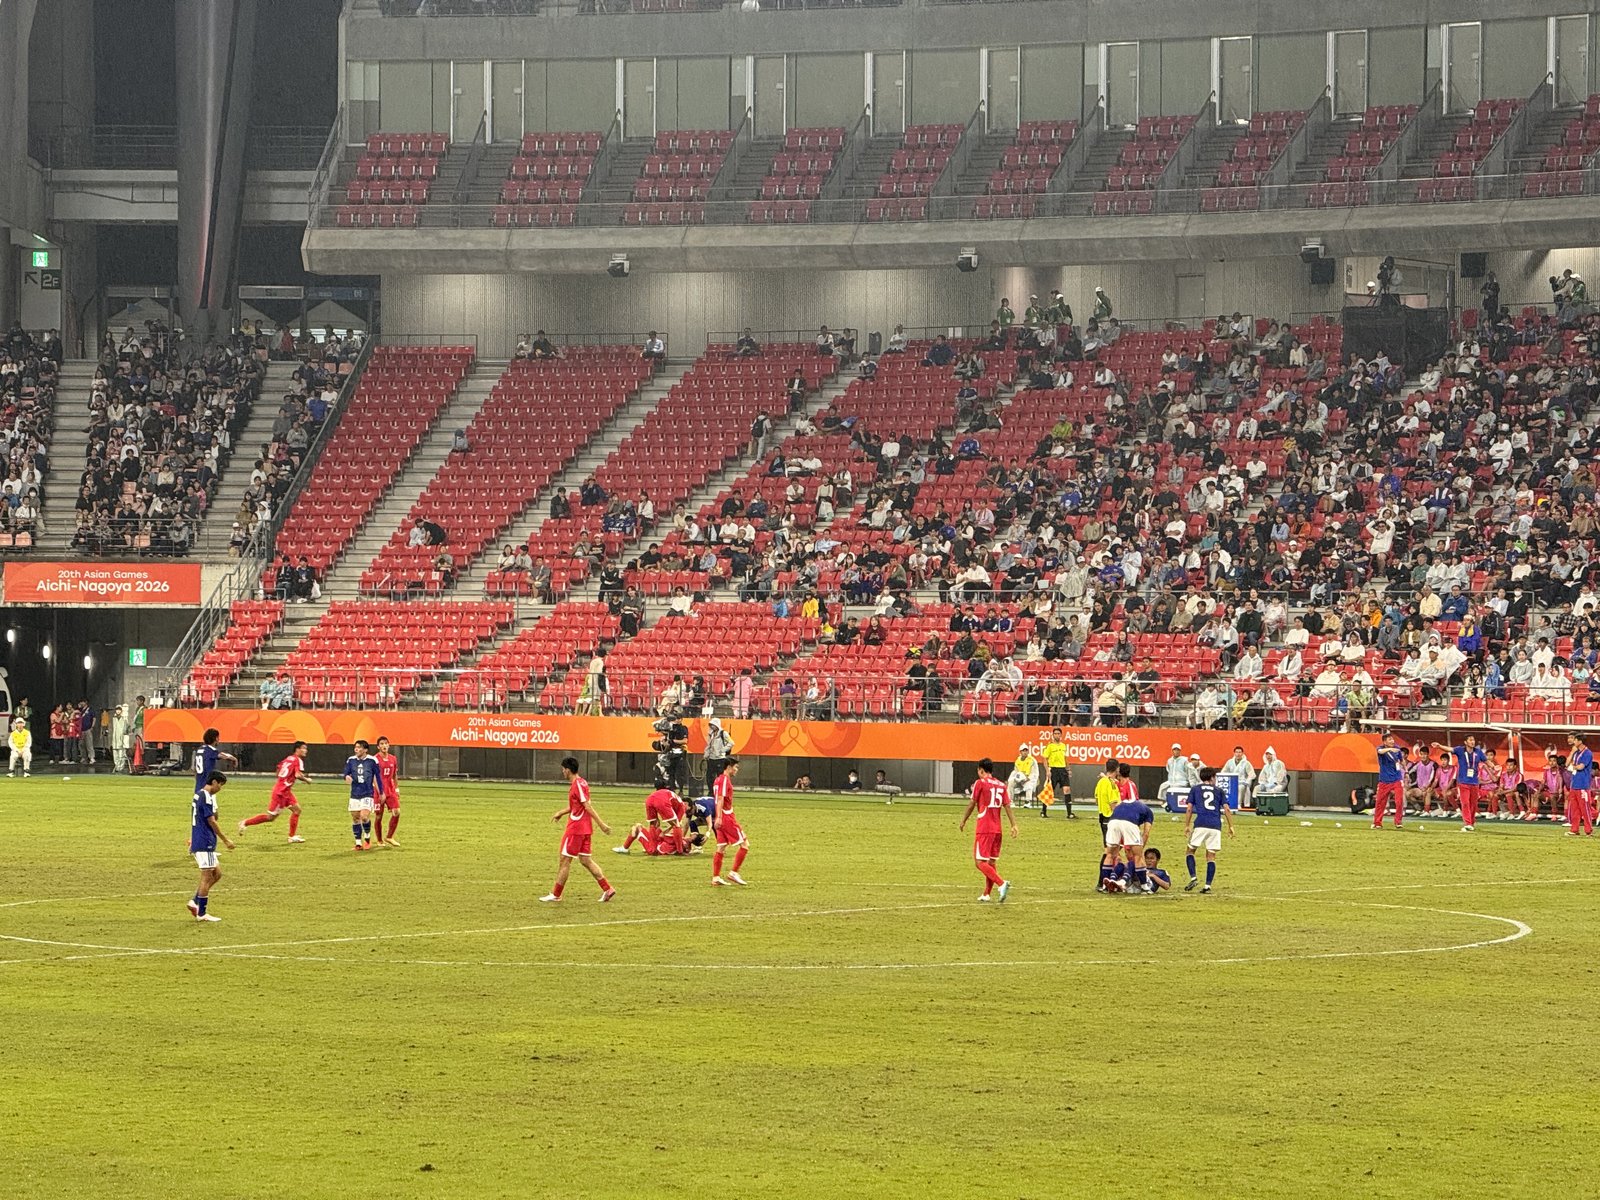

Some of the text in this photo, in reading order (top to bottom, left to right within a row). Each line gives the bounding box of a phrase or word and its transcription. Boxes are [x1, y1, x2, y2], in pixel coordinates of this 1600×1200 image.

[43, 274, 59, 287] 2F
[58, 570, 148, 579] 20th Asian Games
[36, 580, 170, 595] Aichi-Nagoya 2026
[468, 717, 541, 727] 20th Asian Games
[450, 727, 560, 745] Aichi-Nagoya 2026
[1065, 731, 1091, 741] Asian
[1093, 732, 1128, 742] Games
[1115, 745, 1150, 759] 2026
[988, 787, 1004, 808] 15
[1202, 791, 1216, 811] 2
